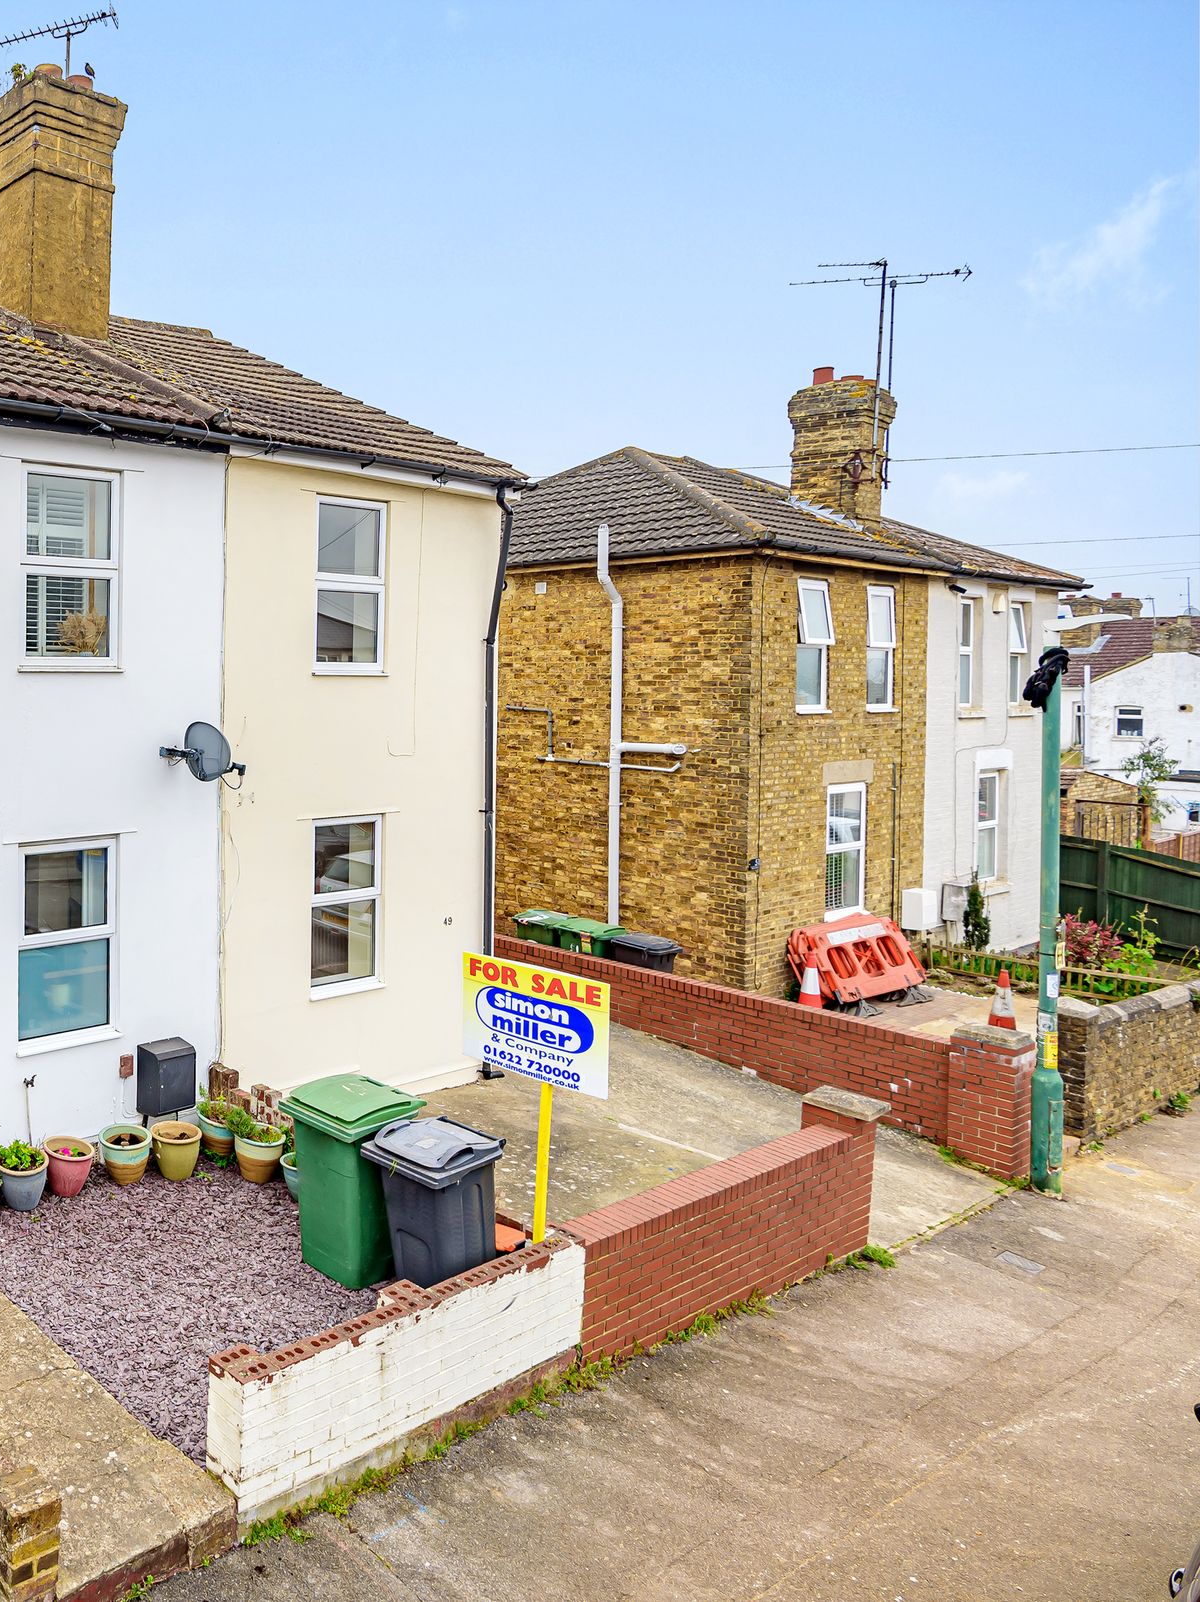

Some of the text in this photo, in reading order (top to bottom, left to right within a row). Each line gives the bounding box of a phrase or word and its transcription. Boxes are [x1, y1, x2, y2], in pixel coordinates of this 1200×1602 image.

[443, 916, 453, 926] 49
[469, 957, 602, 1007] FOR SALE
[493, 992, 570, 1025] simon
[491, 1013, 573, 1048] miller
[483, 1044, 581, 1083] 01622 720000
[491, 1032, 574, 1067] & Company
[483, 1055, 580, 1091] www.simonmiller.co.uk
